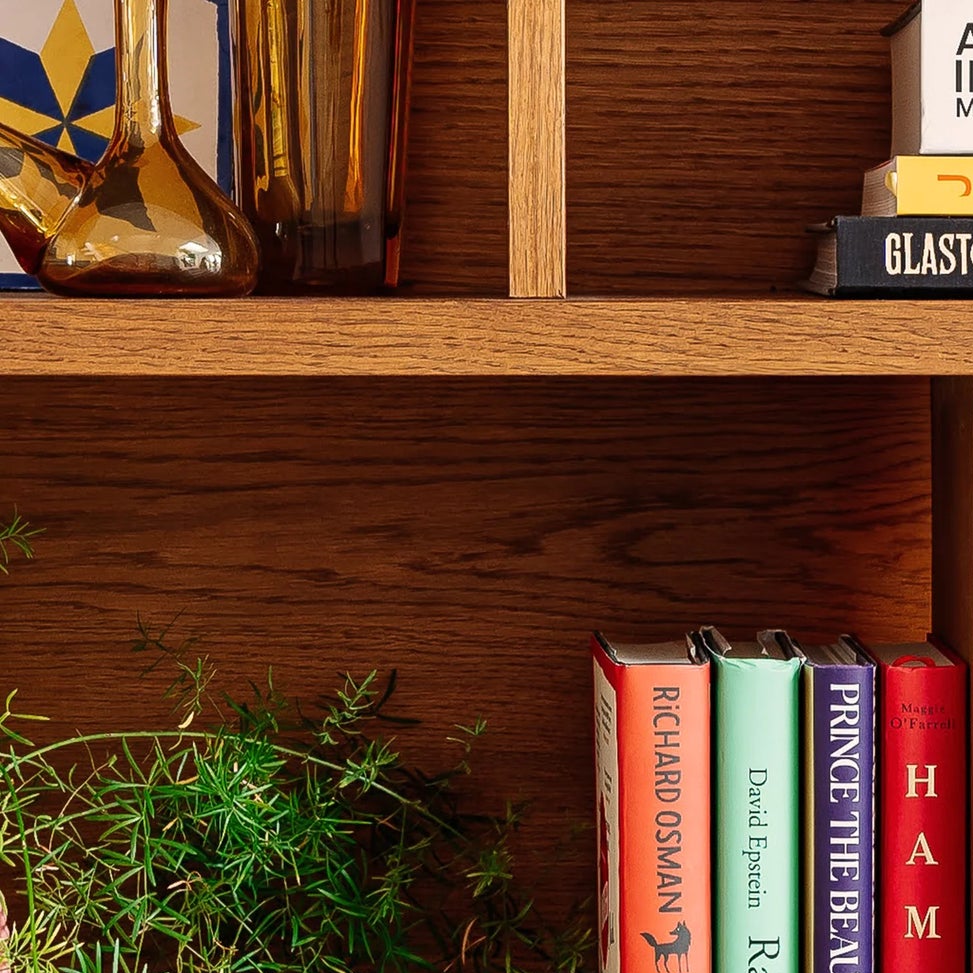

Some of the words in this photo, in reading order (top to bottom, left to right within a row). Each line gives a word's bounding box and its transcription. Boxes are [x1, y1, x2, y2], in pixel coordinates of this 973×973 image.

[829, 683, 860, 803] PRINCE
[748, 768, 768, 828] David
[655, 810, 683, 913] OSMAN
[742, 836, 768, 909] Epstein
[829, 811, 860, 882] THE
